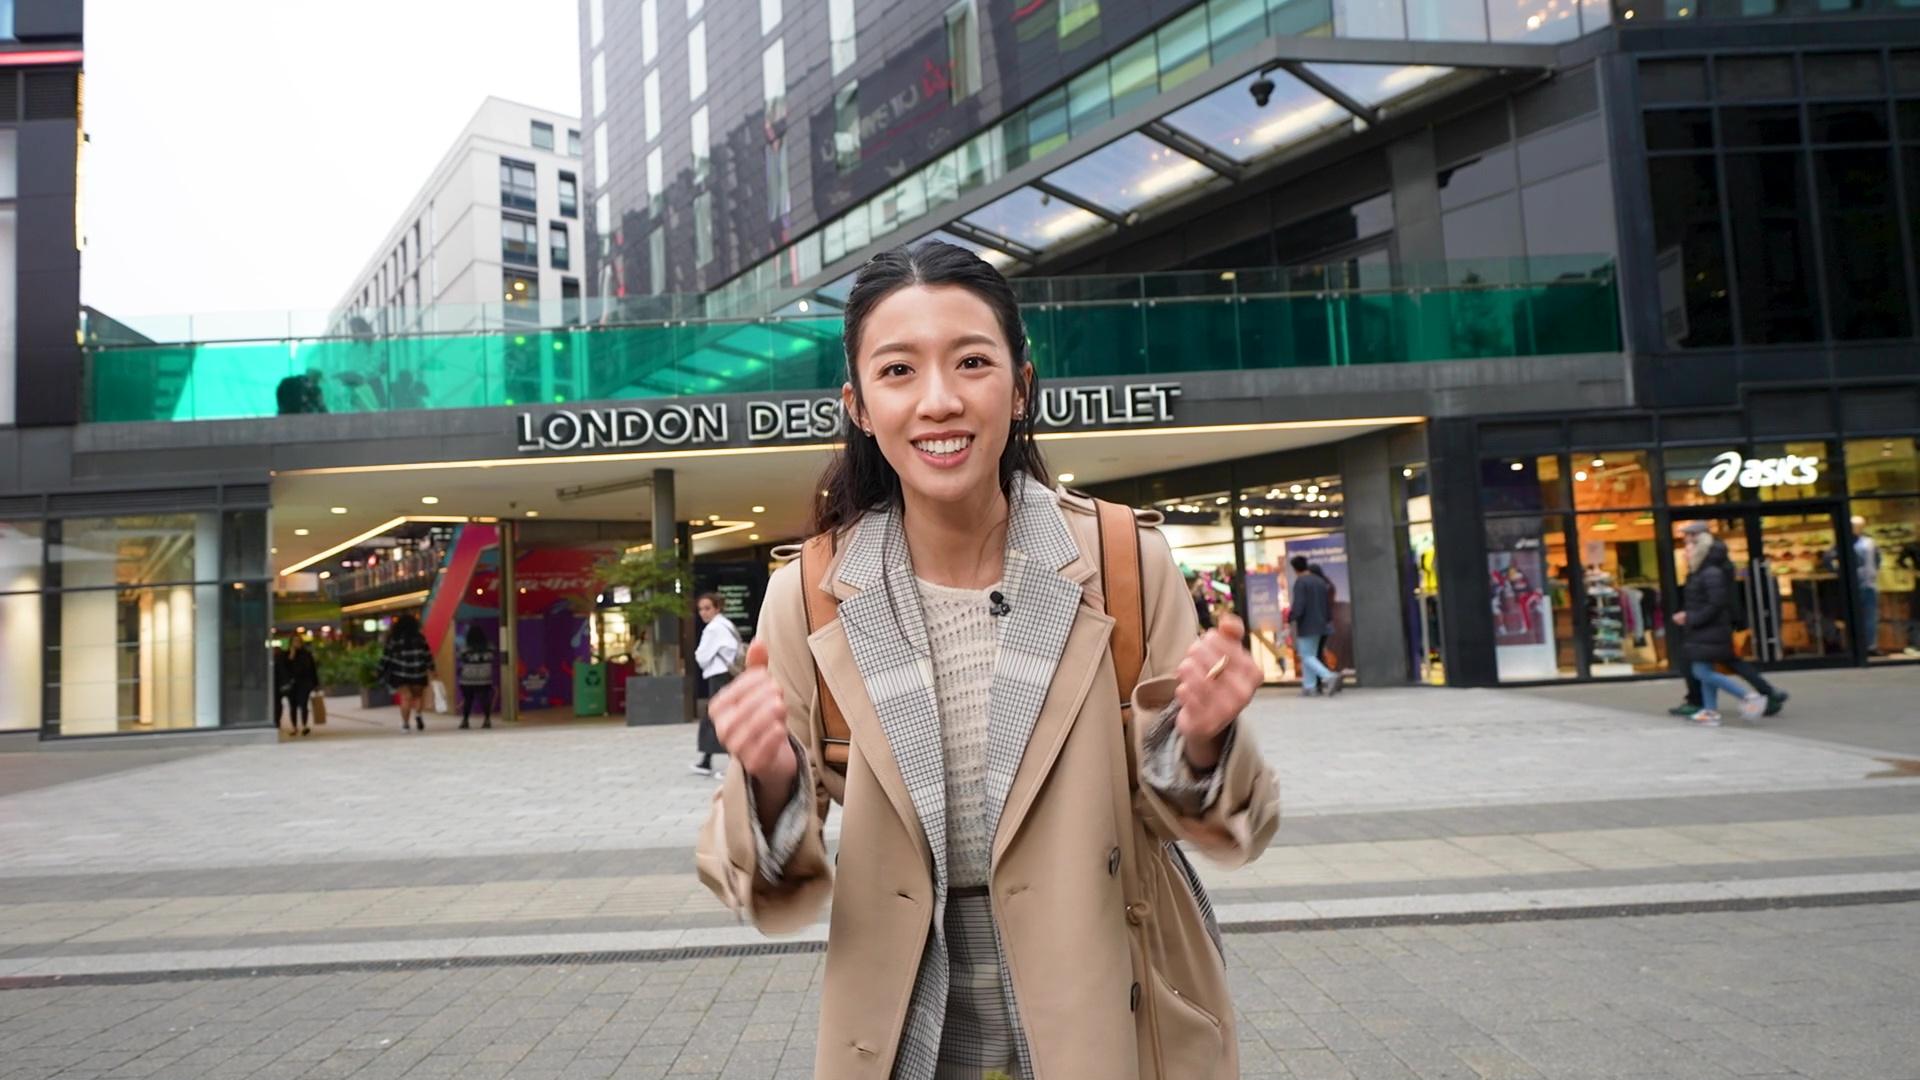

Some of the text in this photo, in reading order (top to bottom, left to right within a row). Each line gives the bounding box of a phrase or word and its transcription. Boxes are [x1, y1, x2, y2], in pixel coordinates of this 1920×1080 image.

[517, 404, 728, 451] LONDON
[1034, 382, 1182, 427] UTLET
[1739, 454, 1819, 488] asics
